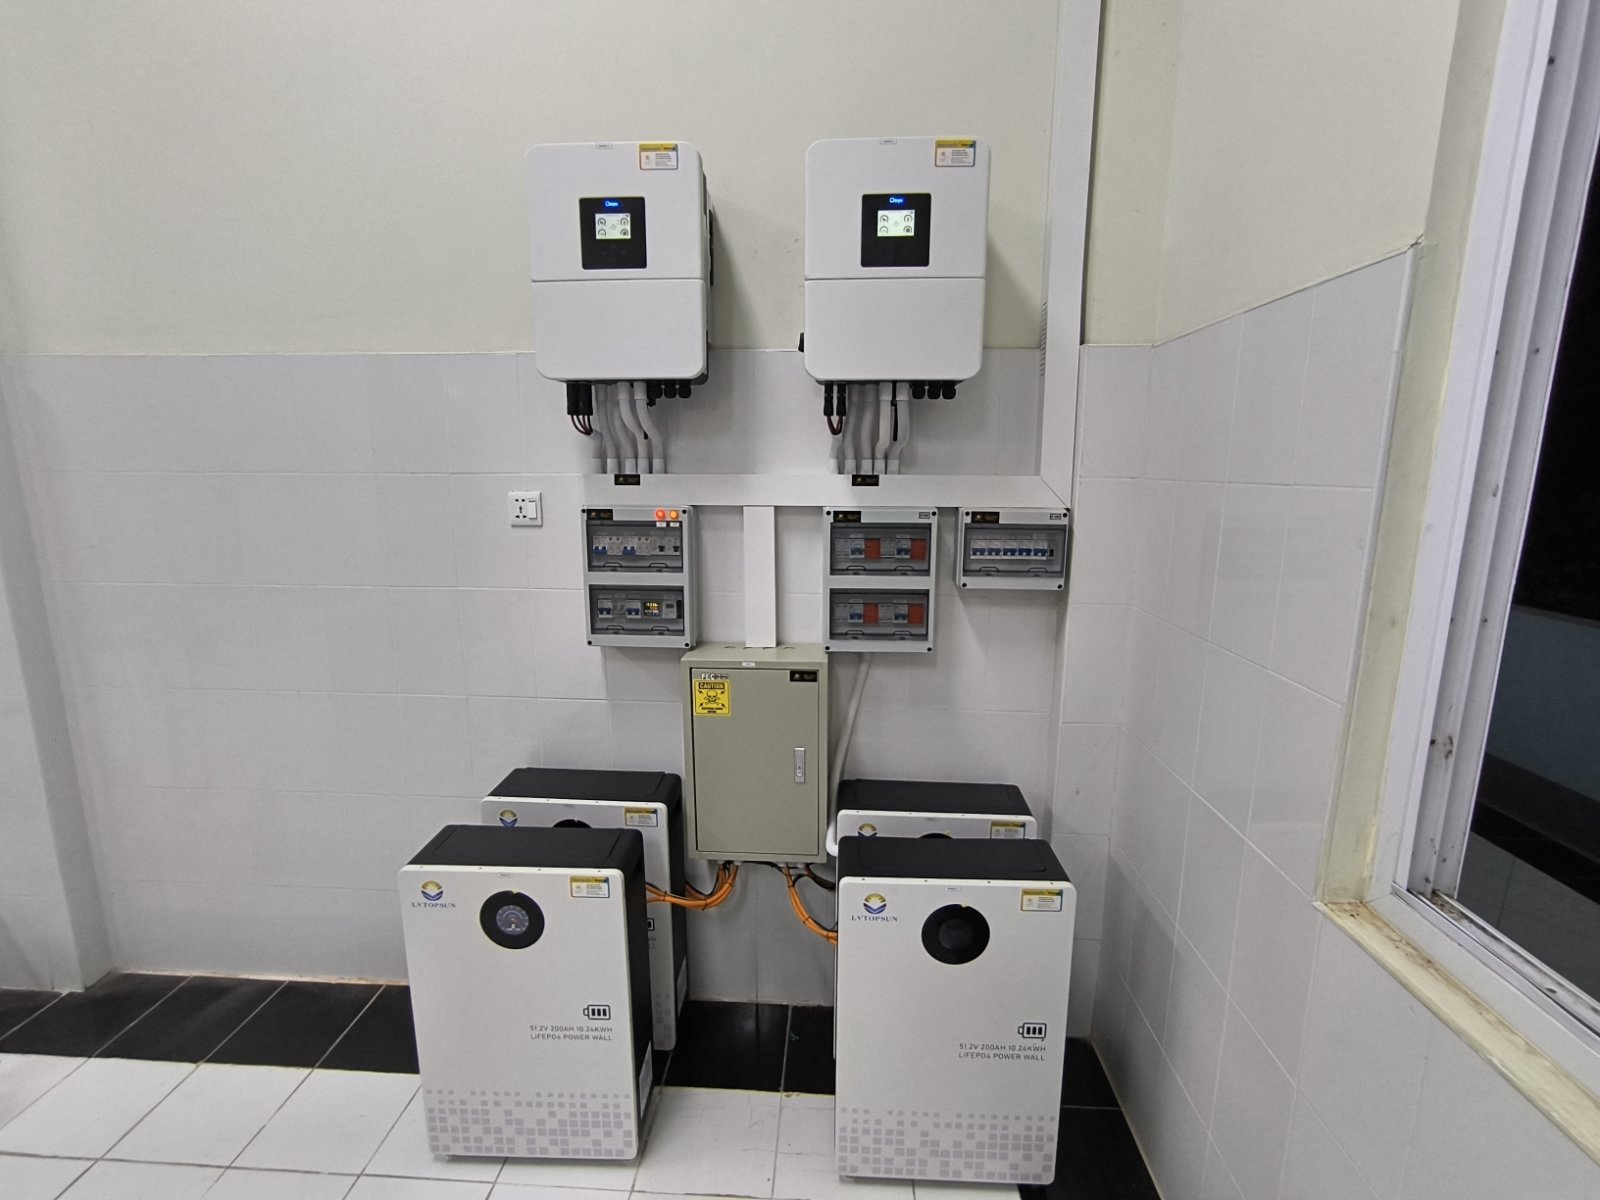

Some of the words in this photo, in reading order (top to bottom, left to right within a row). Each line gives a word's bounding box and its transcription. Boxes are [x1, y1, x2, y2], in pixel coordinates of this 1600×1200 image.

[563, 1033, 590, 1041] POWER
[980, 1043, 1006, 1051] 200AH
[993, 1052, 1021, 1060] POWER
[1023, 1053, 1045, 1061] WALL
